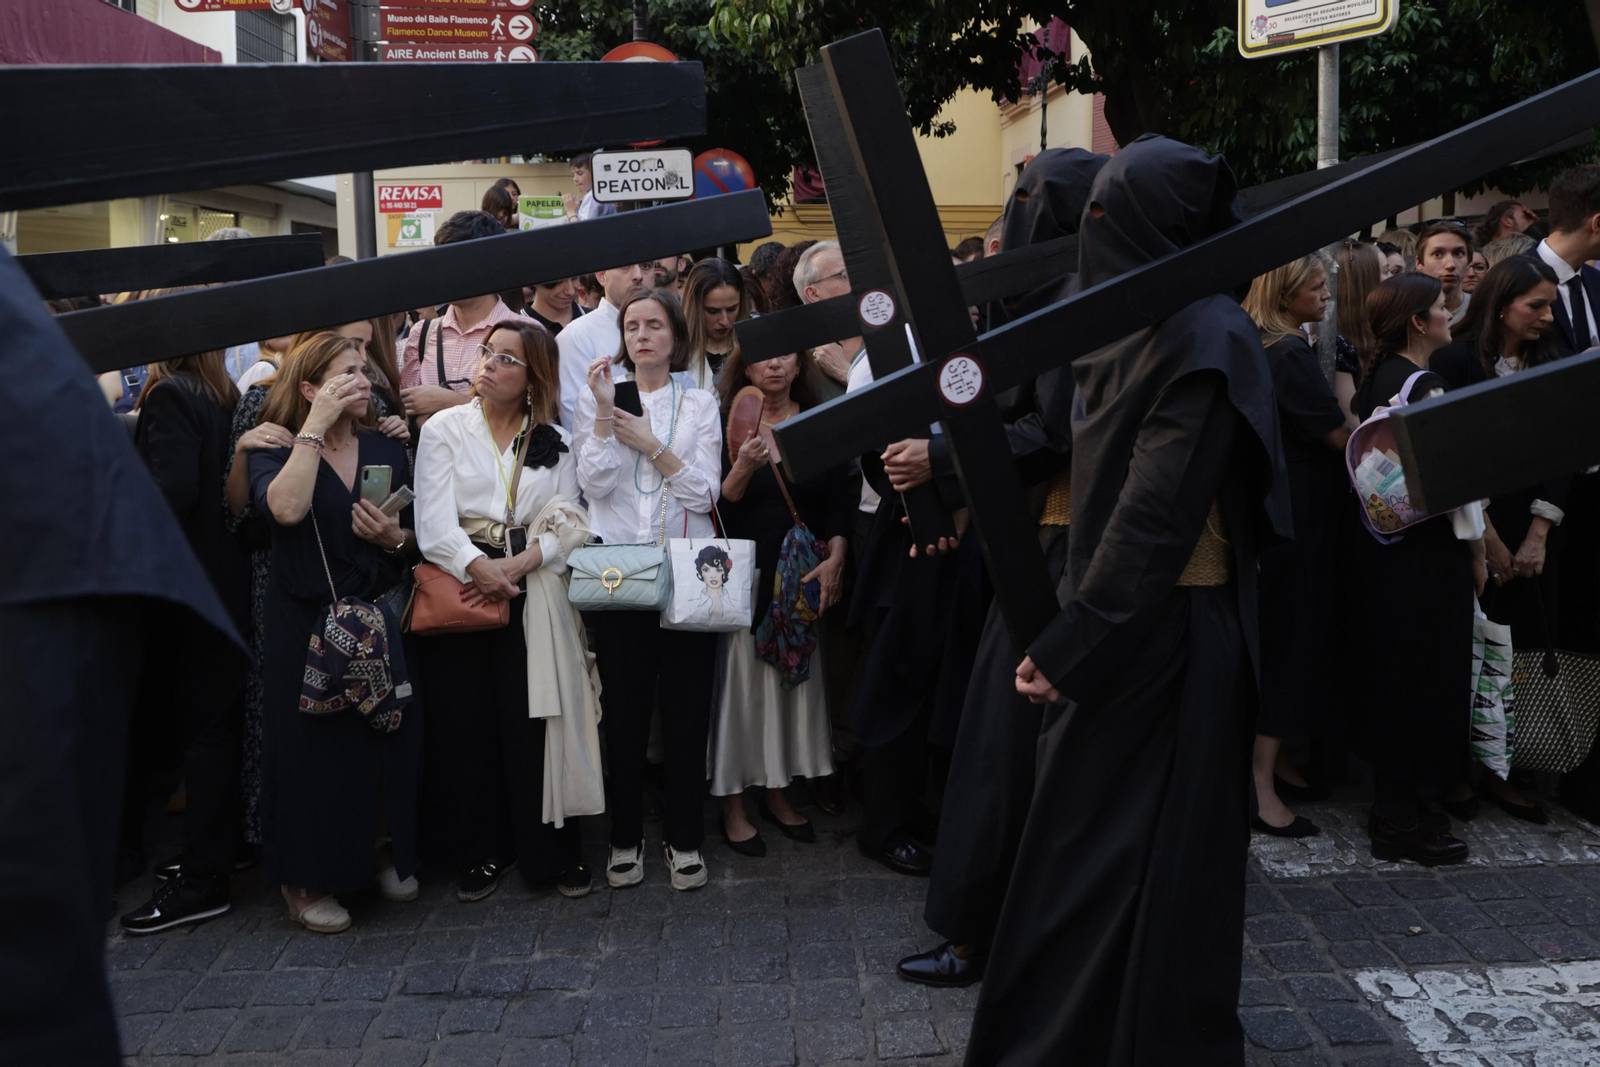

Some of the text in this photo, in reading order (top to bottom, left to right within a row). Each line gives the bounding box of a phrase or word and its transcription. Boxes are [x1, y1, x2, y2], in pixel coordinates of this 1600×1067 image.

[1320, 5, 1346, 15] SEGURIDAD
[387, 14, 488, 24] Museo del Baile Flamenco
[1310, 15, 1328, 23] FIESTAS
[1329, 11, 1351, 20] MAYORES
[387, 27, 488, 37] Flamenco Dance Museum
[387, 49, 489, 60] AIRE Ancient Baths
[618, 158, 665, 173] ZOA
[380, 186, 441, 200] REMSA
